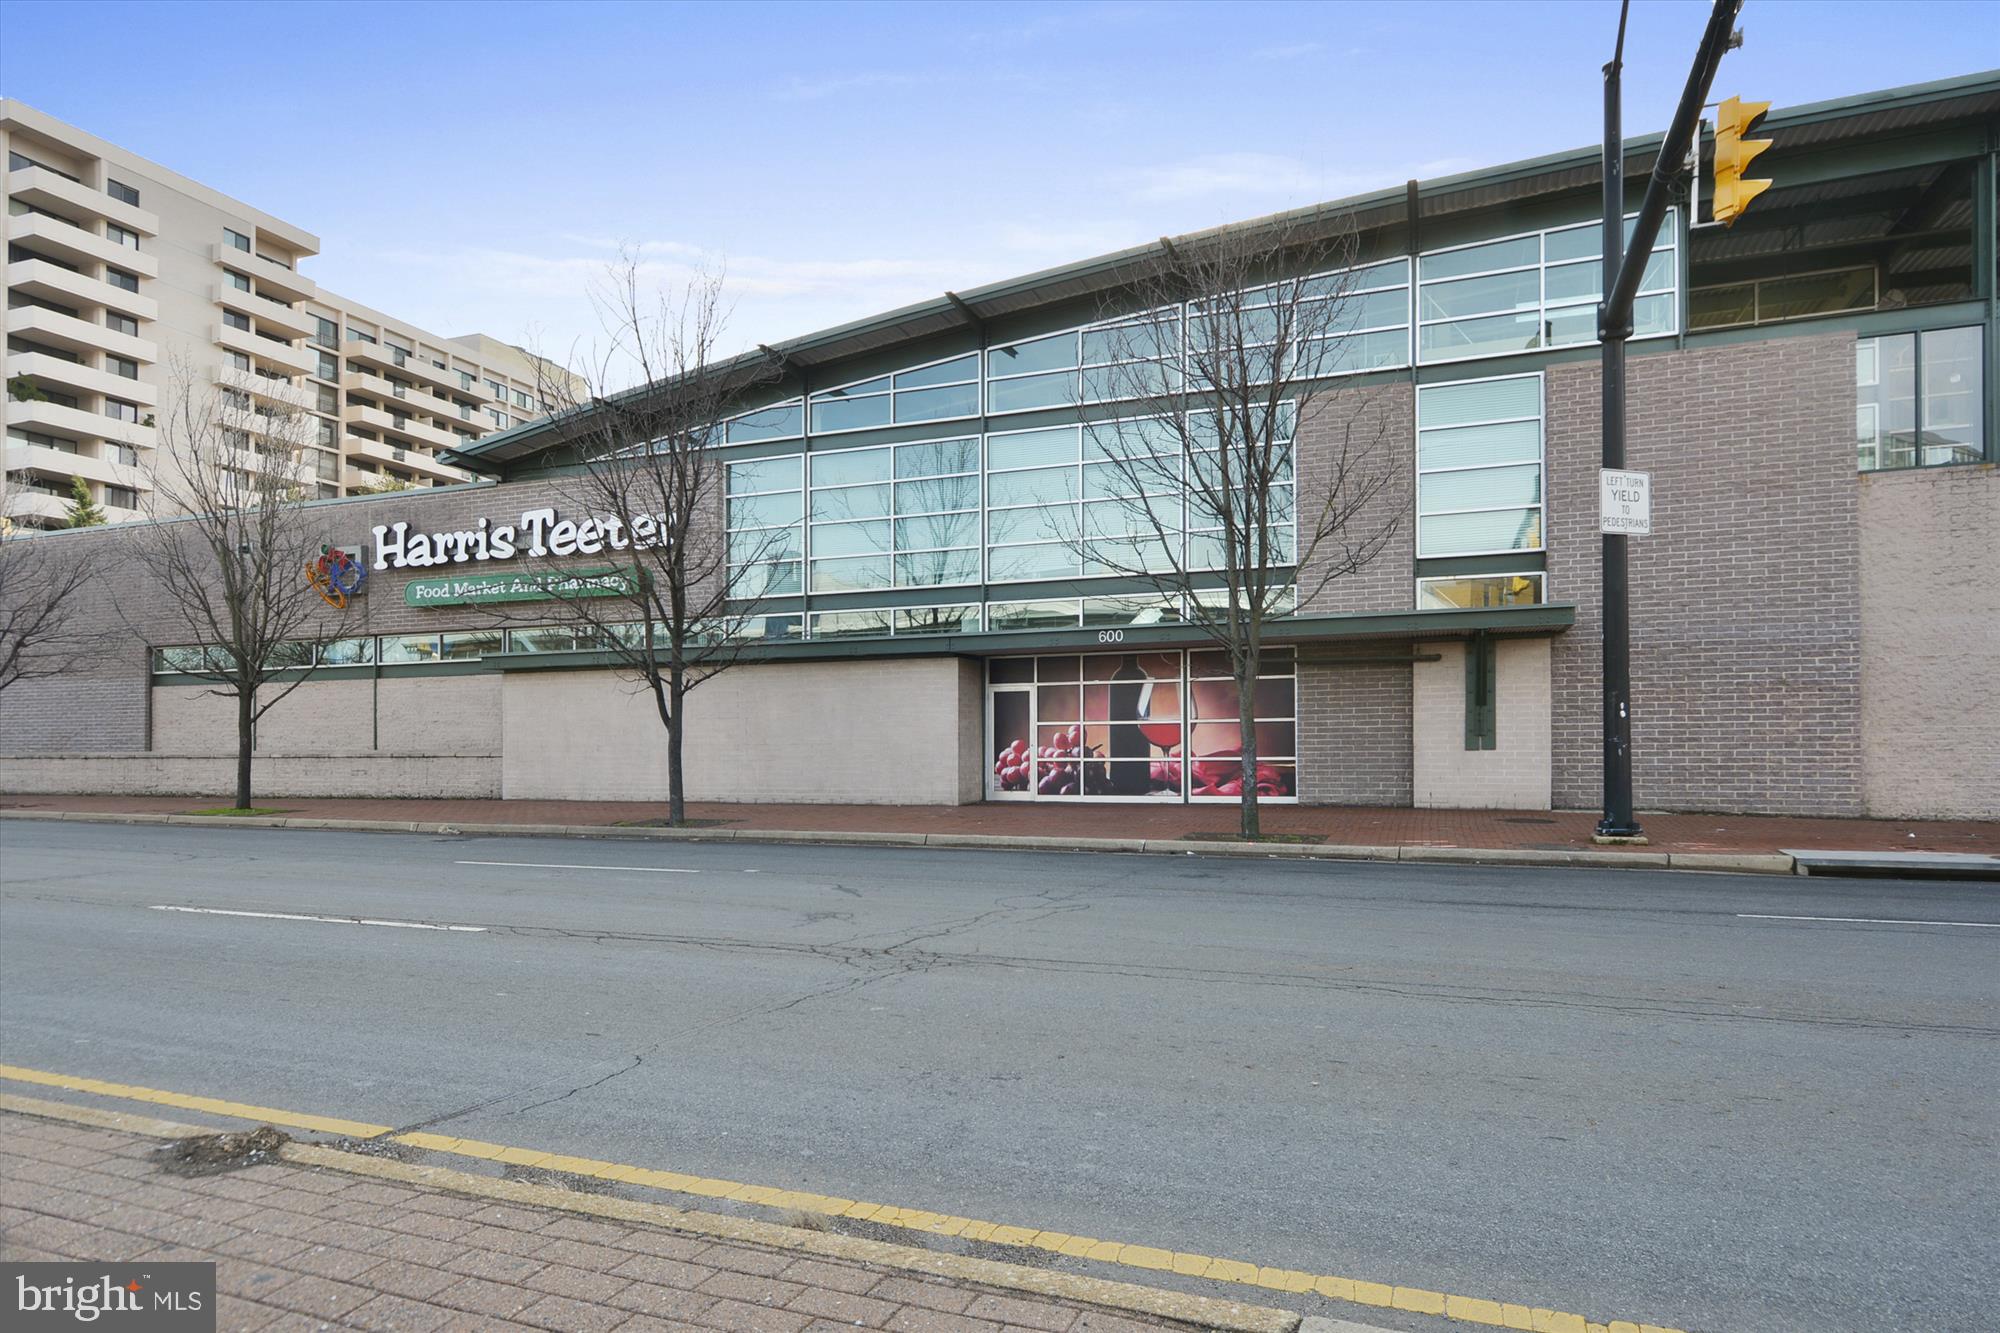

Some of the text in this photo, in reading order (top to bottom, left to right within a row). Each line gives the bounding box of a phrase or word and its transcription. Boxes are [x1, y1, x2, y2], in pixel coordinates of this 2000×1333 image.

[1606, 476, 1644, 488] LEFT TURN
[1611, 489, 1641, 503] YIELD
[1621, 505, 1631, 515] TO
[1603, 516, 1649, 529] PEDESTRIANS
[372, 517, 516, 570] Harris
[415, 574, 629, 599] Food Market And Pharmacy
[1098, 629, 1124, 643] 600
